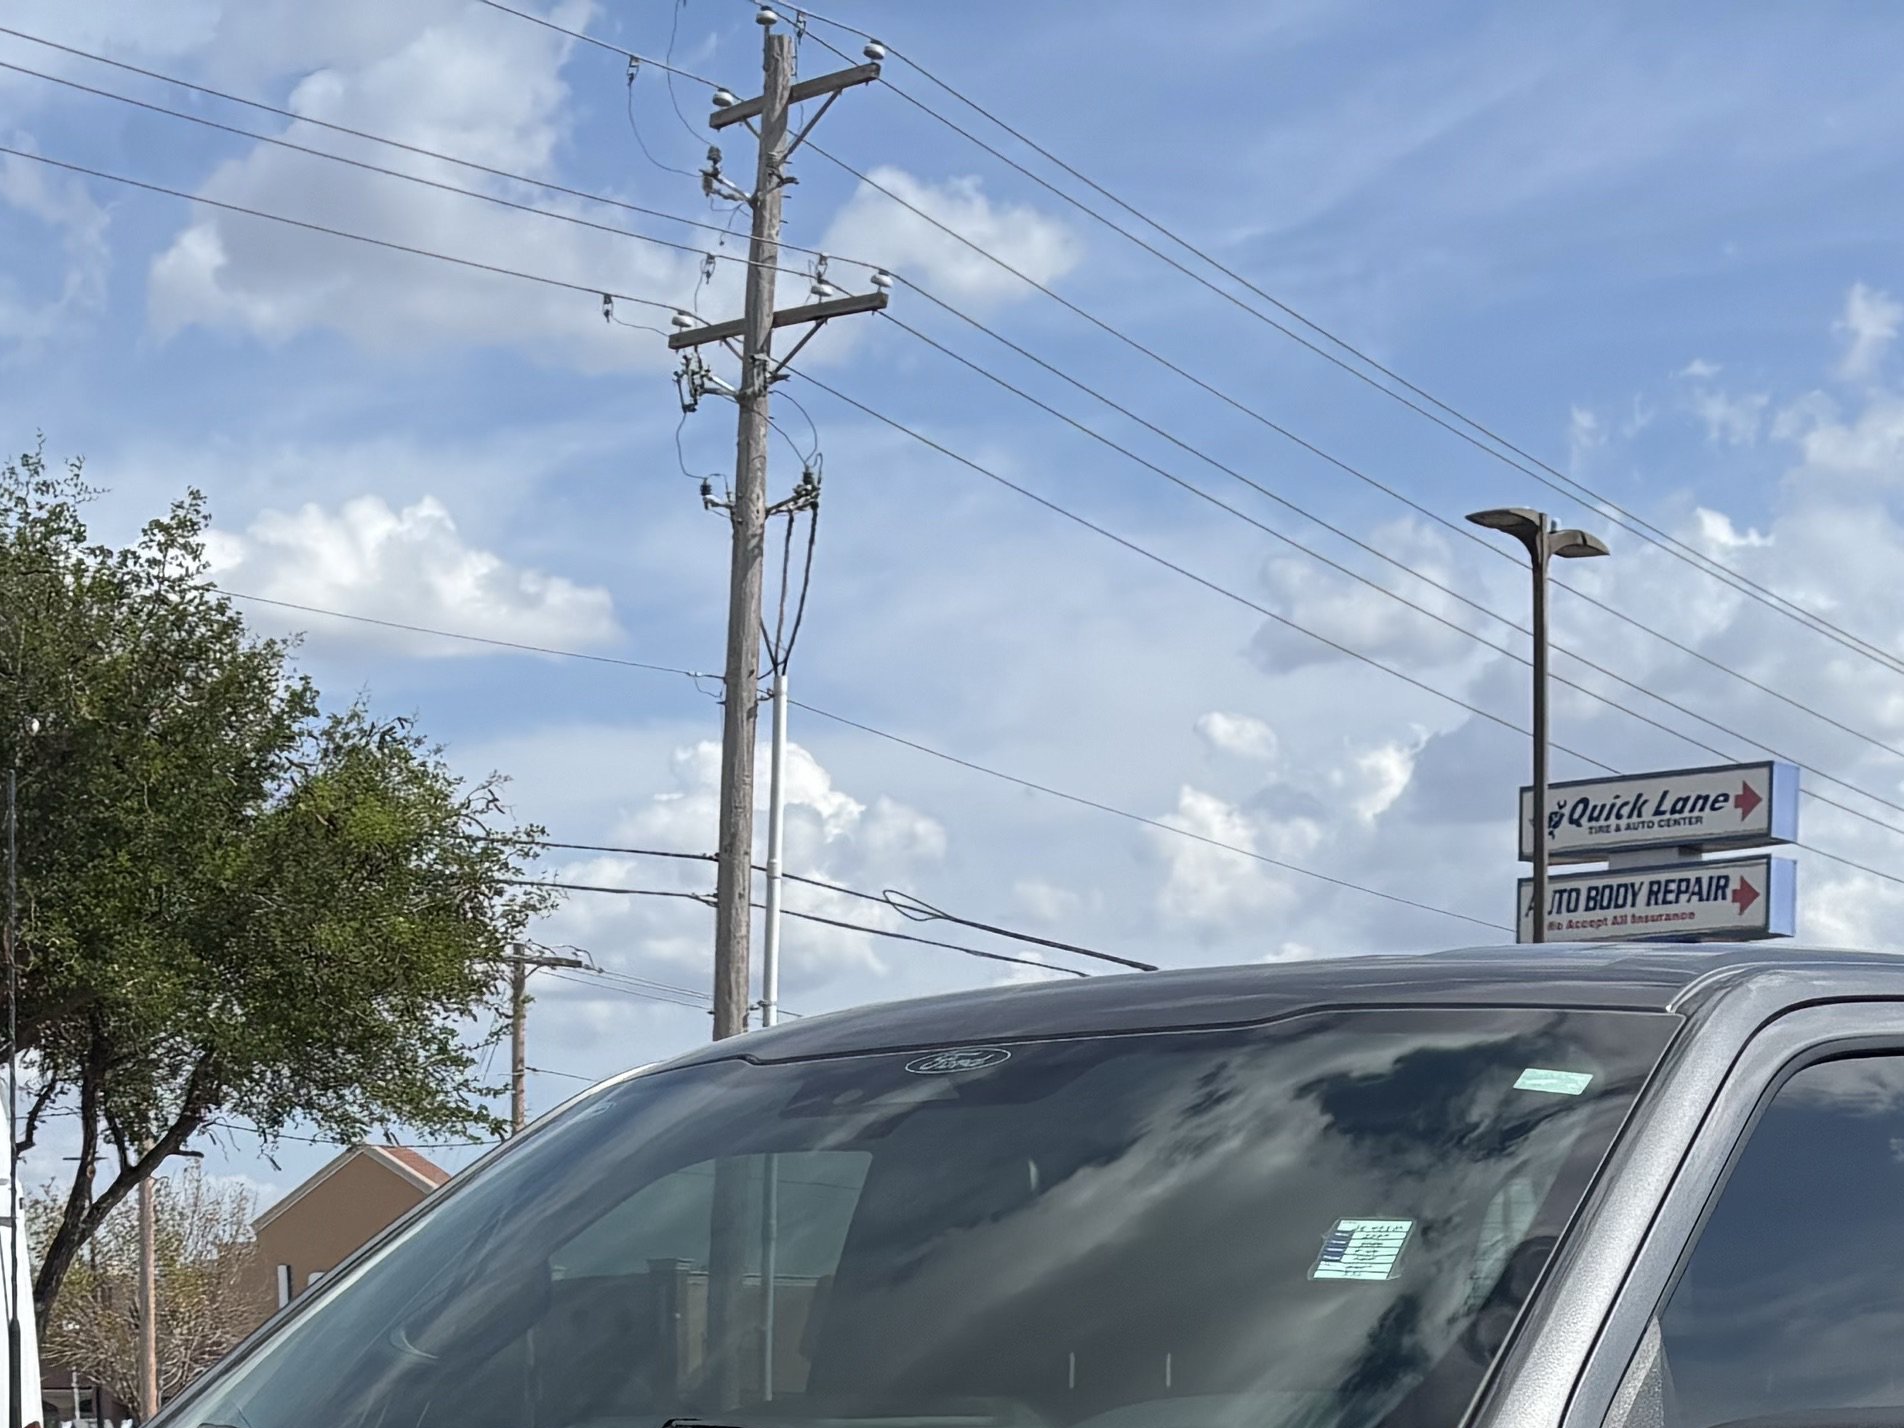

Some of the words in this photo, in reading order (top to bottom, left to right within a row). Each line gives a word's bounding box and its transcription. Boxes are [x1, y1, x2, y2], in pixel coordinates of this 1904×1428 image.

[1568, 792, 1651, 828] Quick
[1652, 790, 1731, 817] Lane
[1588, 824, 1611, 835] TIRE
[1624, 820, 1655, 832] AUTO
[1657, 816, 1704, 829] CENTER
[1584, 881, 1645, 912] BODY
[1646, 875, 1731, 907] REPAIR
